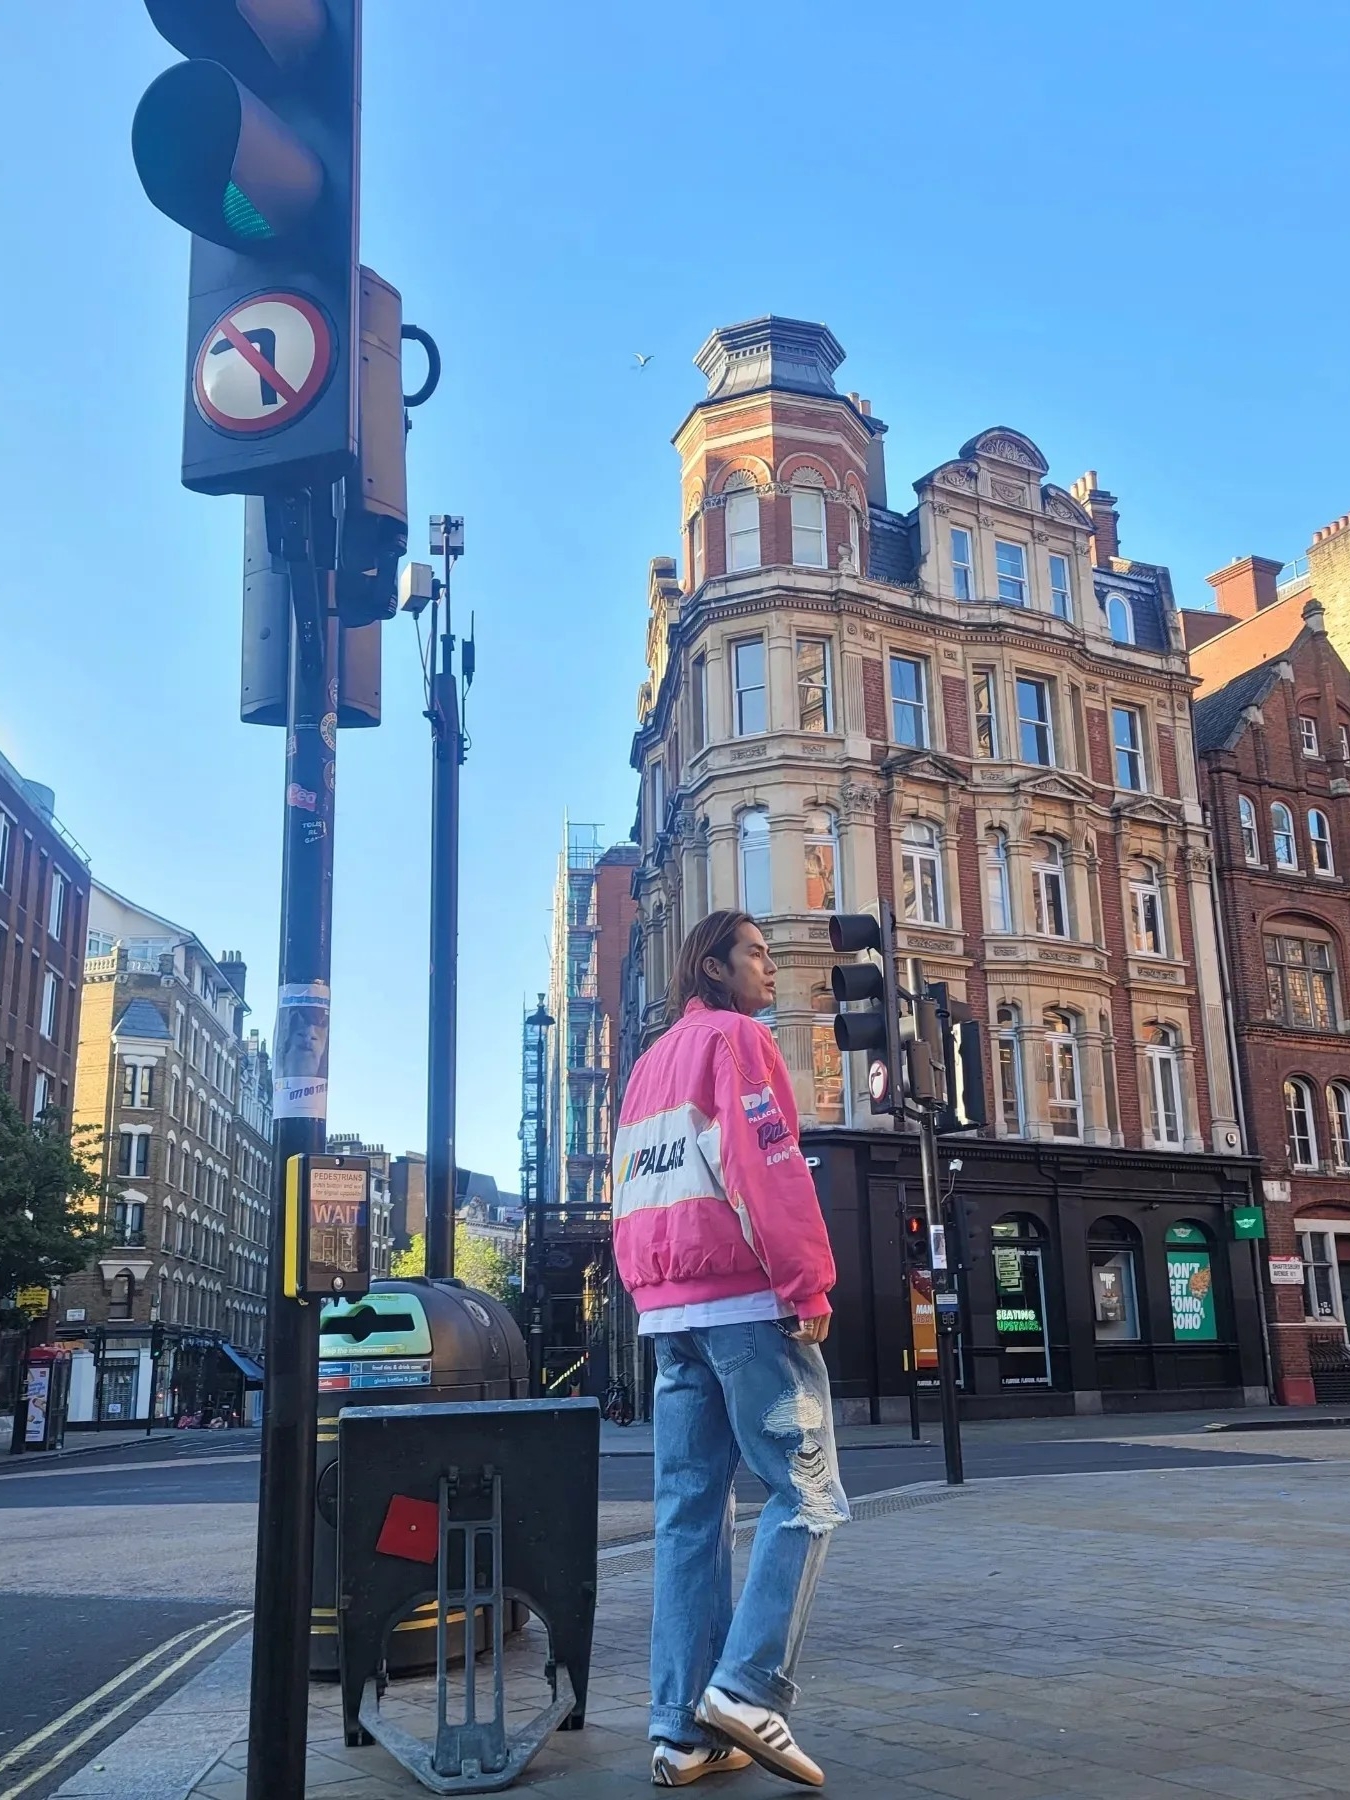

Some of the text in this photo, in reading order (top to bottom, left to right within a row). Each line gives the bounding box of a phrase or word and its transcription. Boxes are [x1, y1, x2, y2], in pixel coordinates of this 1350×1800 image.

[748, 1108, 777, 1124] PALACE
[314, 1172, 363, 1182] PEDESTRIANS
[313, 1204, 360, 1224] WAIT
[996, 1309, 1035, 1321] SEATING
